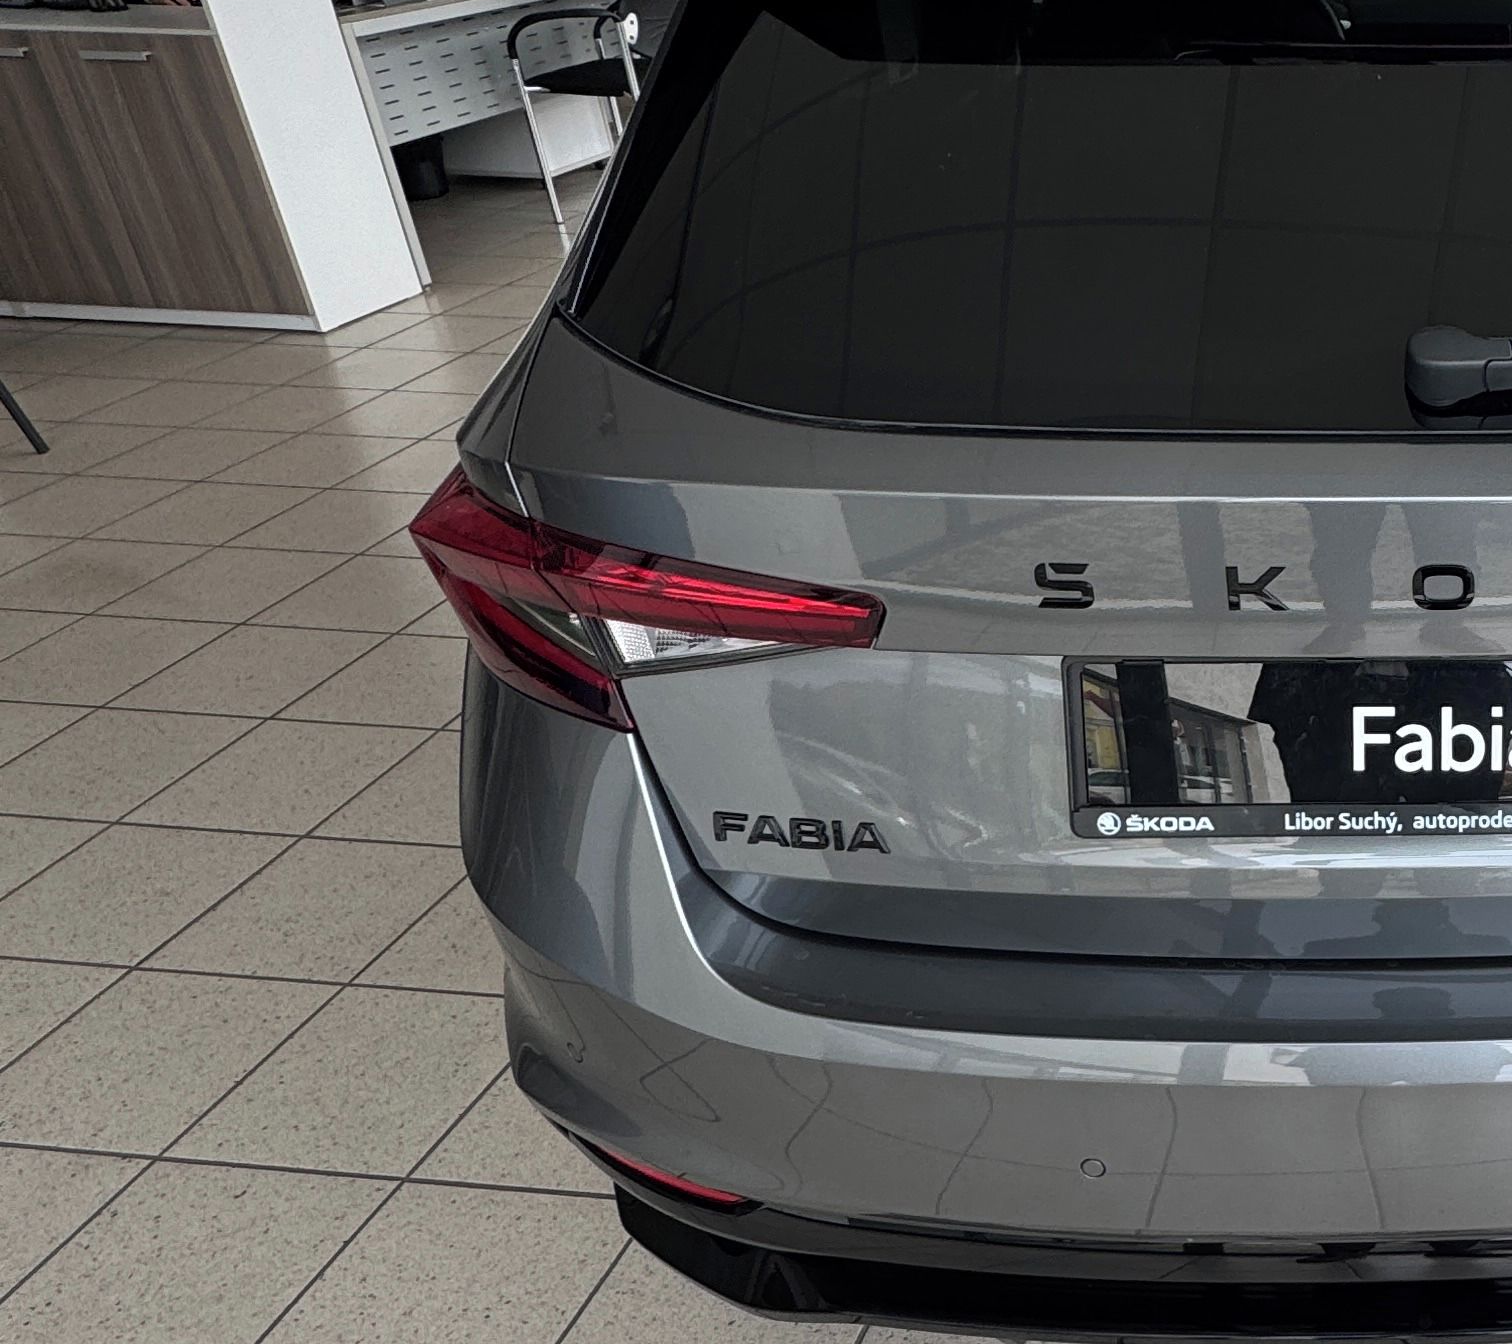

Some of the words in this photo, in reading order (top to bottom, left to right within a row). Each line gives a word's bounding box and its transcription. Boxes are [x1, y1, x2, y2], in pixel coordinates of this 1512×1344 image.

[713, 811, 891, 854] FABIA
[1126, 814, 1215, 832] ŠKODA
[1284, 812, 1334, 831] Libor
[1338, 811, 1403, 834] Suchý,
